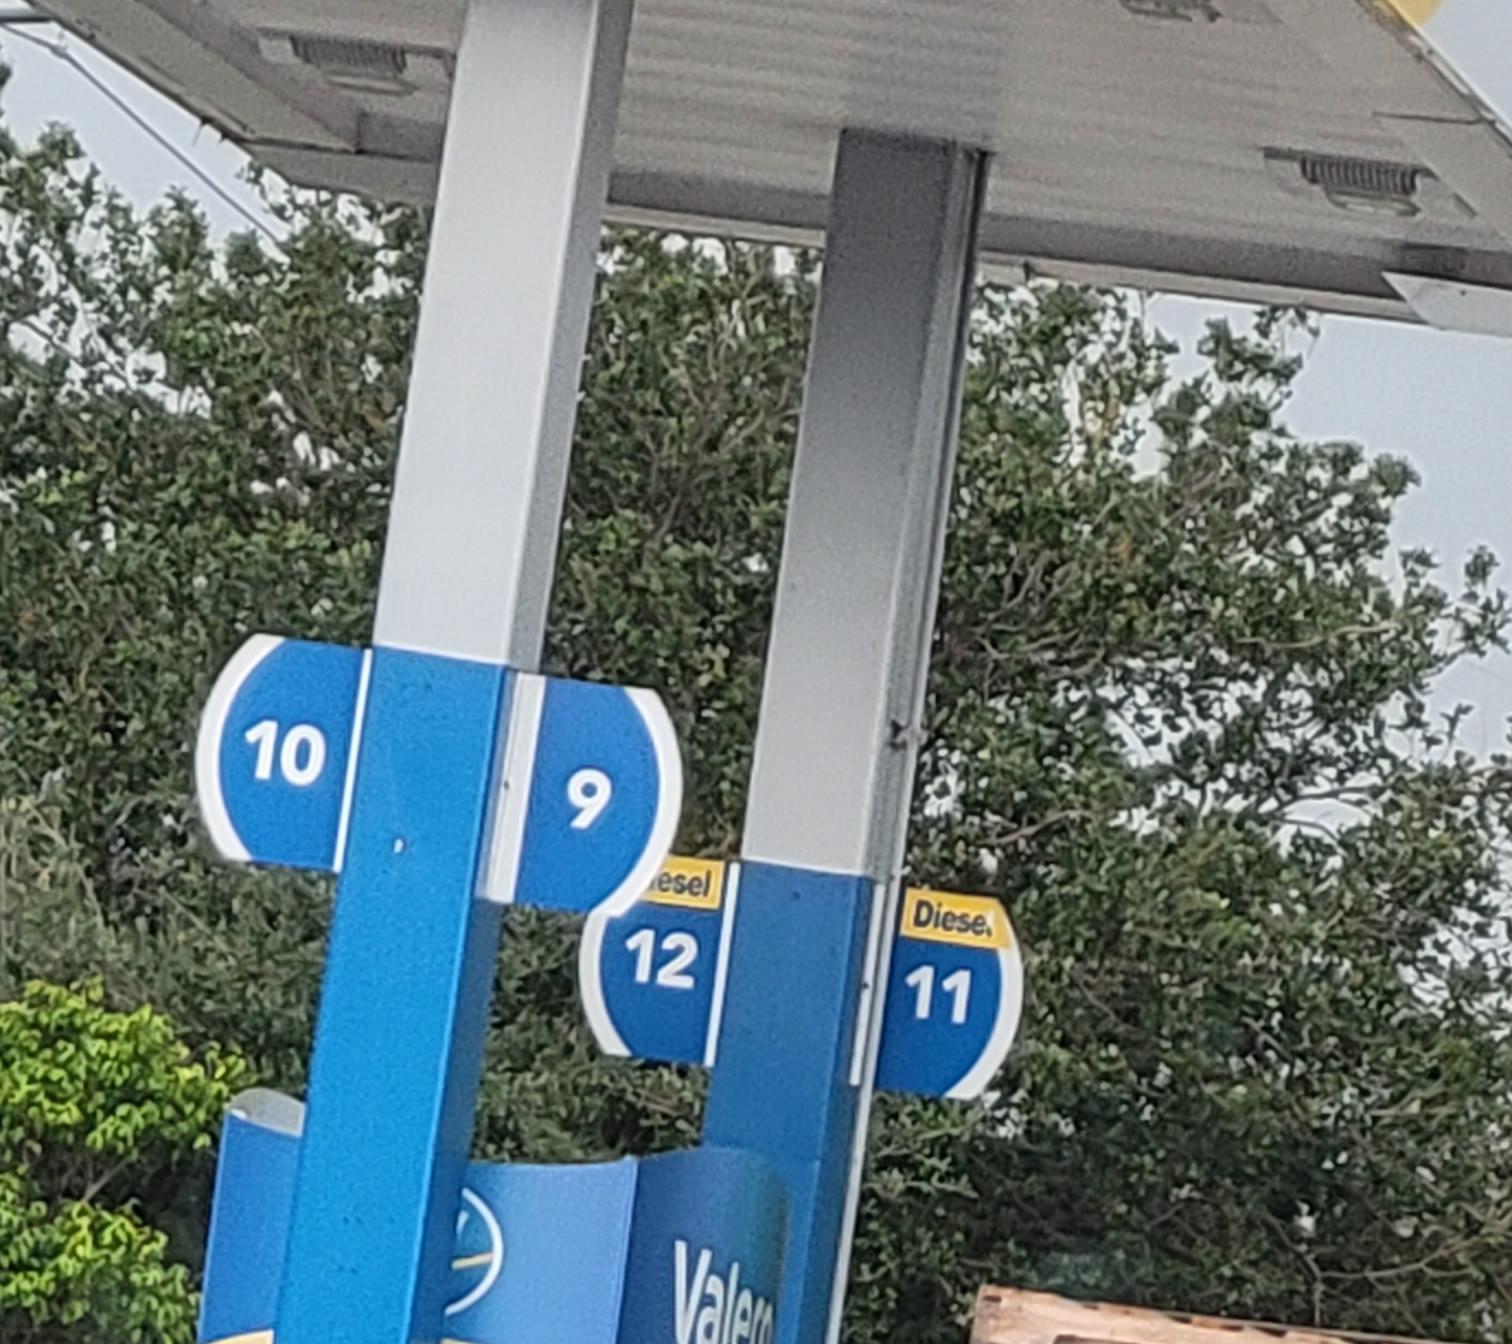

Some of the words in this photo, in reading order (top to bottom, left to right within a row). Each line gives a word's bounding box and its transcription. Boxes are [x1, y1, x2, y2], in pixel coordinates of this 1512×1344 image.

[244, 719, 326, 787] 10
[566, 768, 613, 830] 9
[649, 869, 713, 898] esel
[625, 928, 699, 989] 12
[904, 964, 972, 1024] 11
